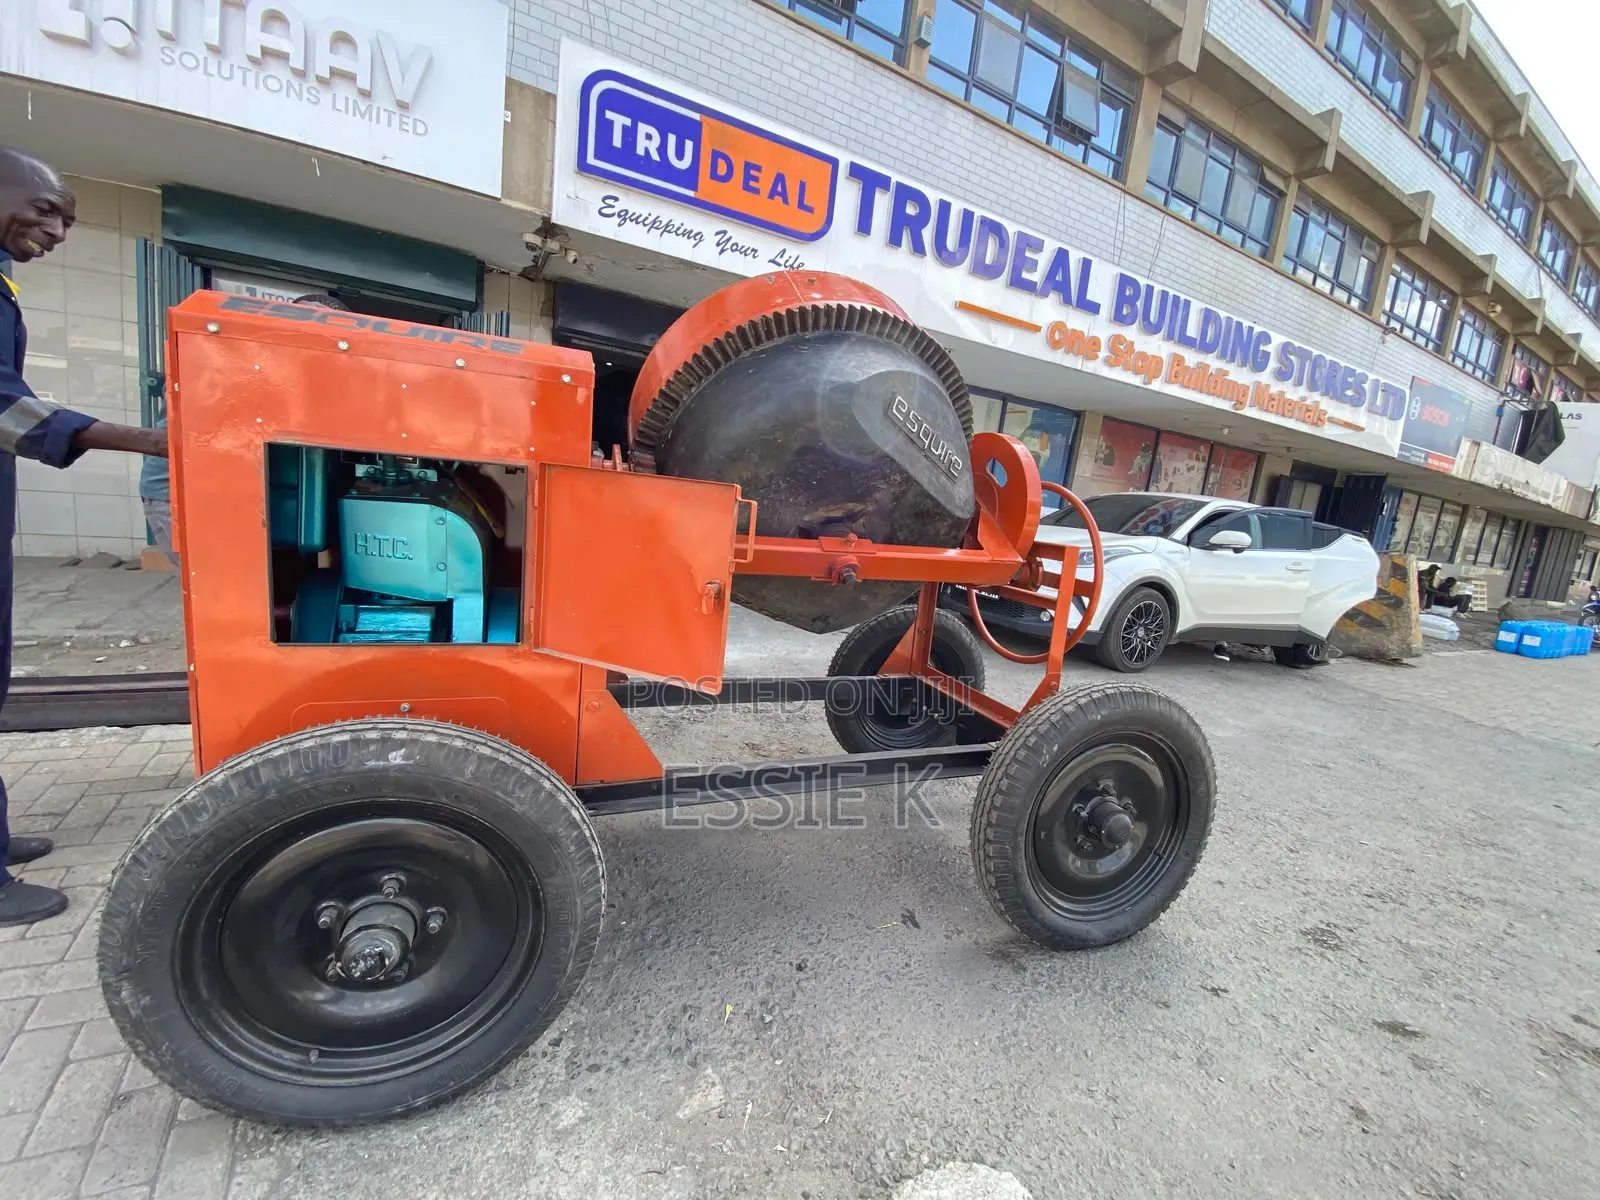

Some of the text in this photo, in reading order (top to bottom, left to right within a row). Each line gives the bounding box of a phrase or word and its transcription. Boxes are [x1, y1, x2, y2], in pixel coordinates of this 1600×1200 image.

[160, 46, 429, 136] SOLUTIONS LIMITED
[598, 194, 805, 272] Equipping Your Life
[218, 296, 526, 355] ESQUIRE
[847, 160, 1407, 422] TRUDEAL BUILDING STORES LTD
[1109, 332, 1163, 382] Stop
[1167, 352, 1251, 411] Building
[1254, 381, 1329, 427] Materials
[354, 532, 413, 560] H.T.C.
